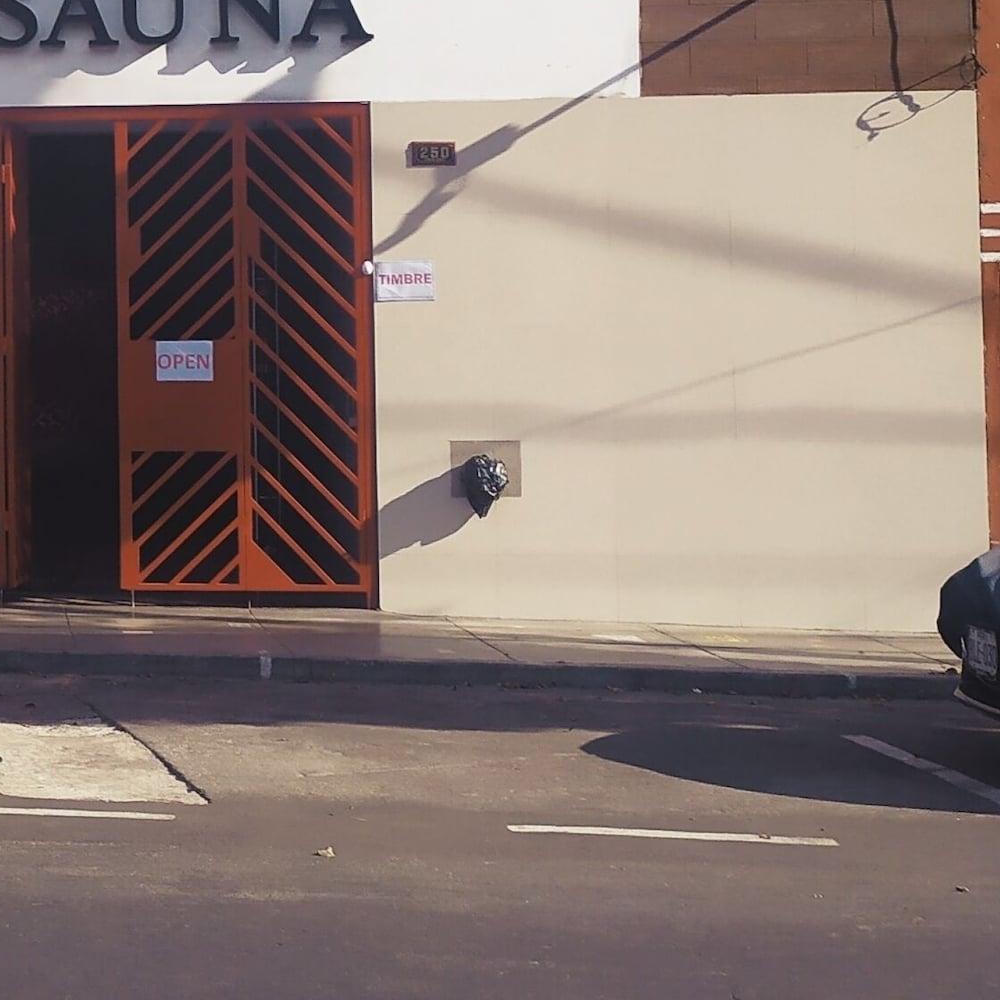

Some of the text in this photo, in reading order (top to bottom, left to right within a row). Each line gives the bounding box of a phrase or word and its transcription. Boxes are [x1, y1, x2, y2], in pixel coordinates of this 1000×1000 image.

[419, 146, 450, 160] 250
[378, 273, 433, 285] TIMBRE
[157, 354, 210, 370] OPEN
